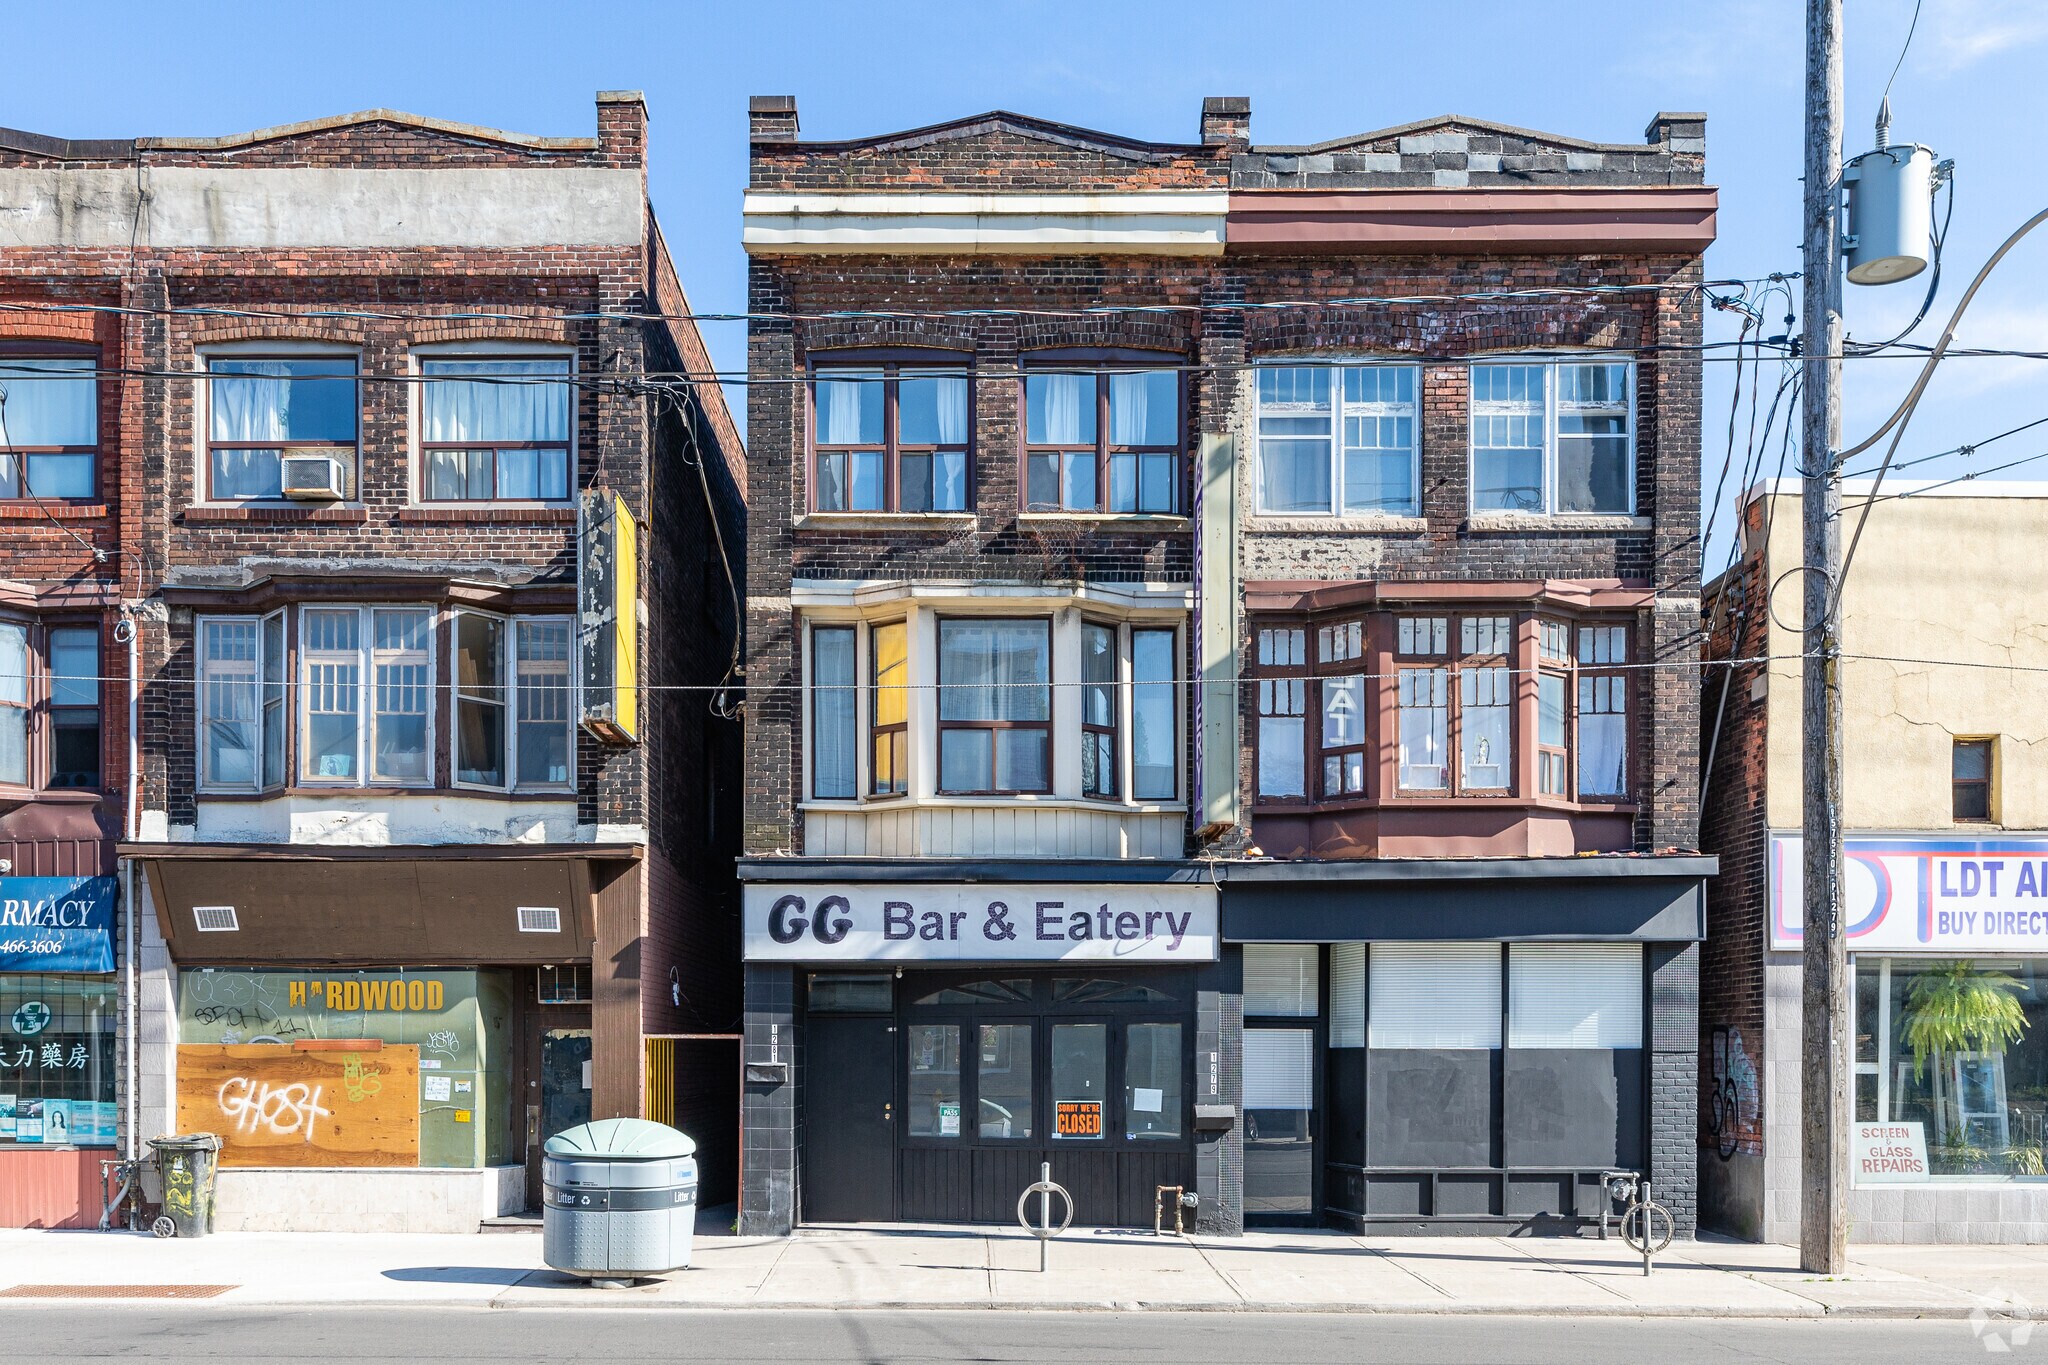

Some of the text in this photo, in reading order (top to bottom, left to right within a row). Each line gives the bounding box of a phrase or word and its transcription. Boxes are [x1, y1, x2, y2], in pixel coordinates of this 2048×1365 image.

[1940, 861, 2004, 897] LDT
[0, 899, 95, 927] RMACY
[767, 894, 1192, 951] GG Bar & Eatery
[1938, 911, 1978, 935] BUY
[1058, 1104, 1100, 1112] SORRY WE'RE
[1058, 1113, 1100, 1134] CLOSED
[1861, 1127, 1910, 1139] SCREEN
[1869, 1146, 1913, 1158] GLASS
[1861, 1158, 1924, 1173] REPAIRS
[557, 1191, 576, 1204] Litter
[674, 1191, 689, 1203] Litter
